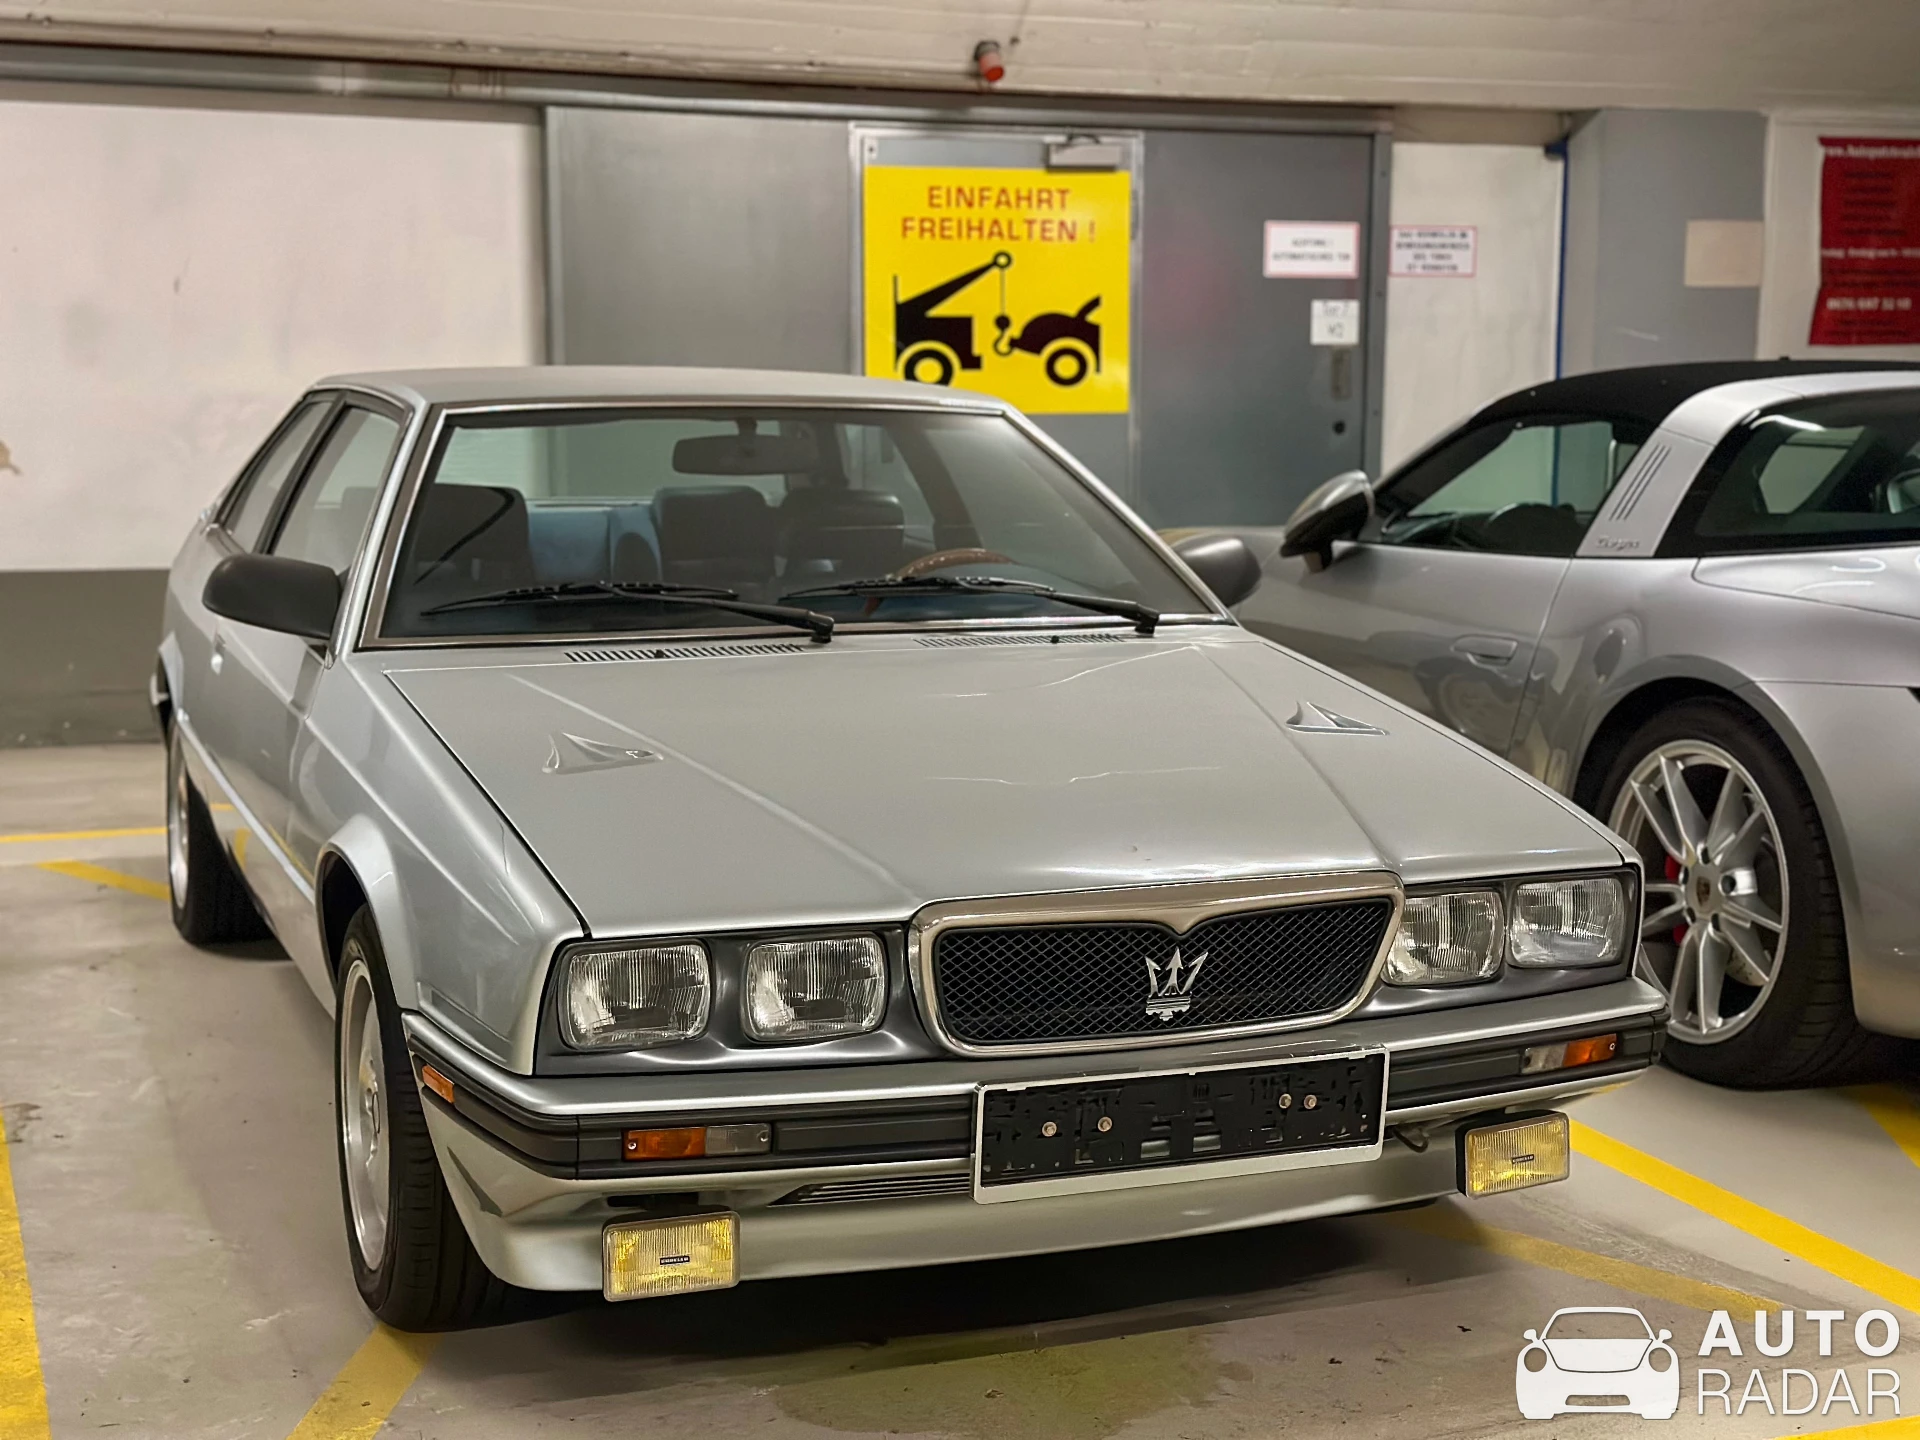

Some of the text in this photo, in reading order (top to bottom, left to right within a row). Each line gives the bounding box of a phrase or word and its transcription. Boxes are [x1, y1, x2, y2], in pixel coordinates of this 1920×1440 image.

[928, 186, 1071, 210] EINFAHRT
[902, 217, 1096, 242] FREIHALTEN !
